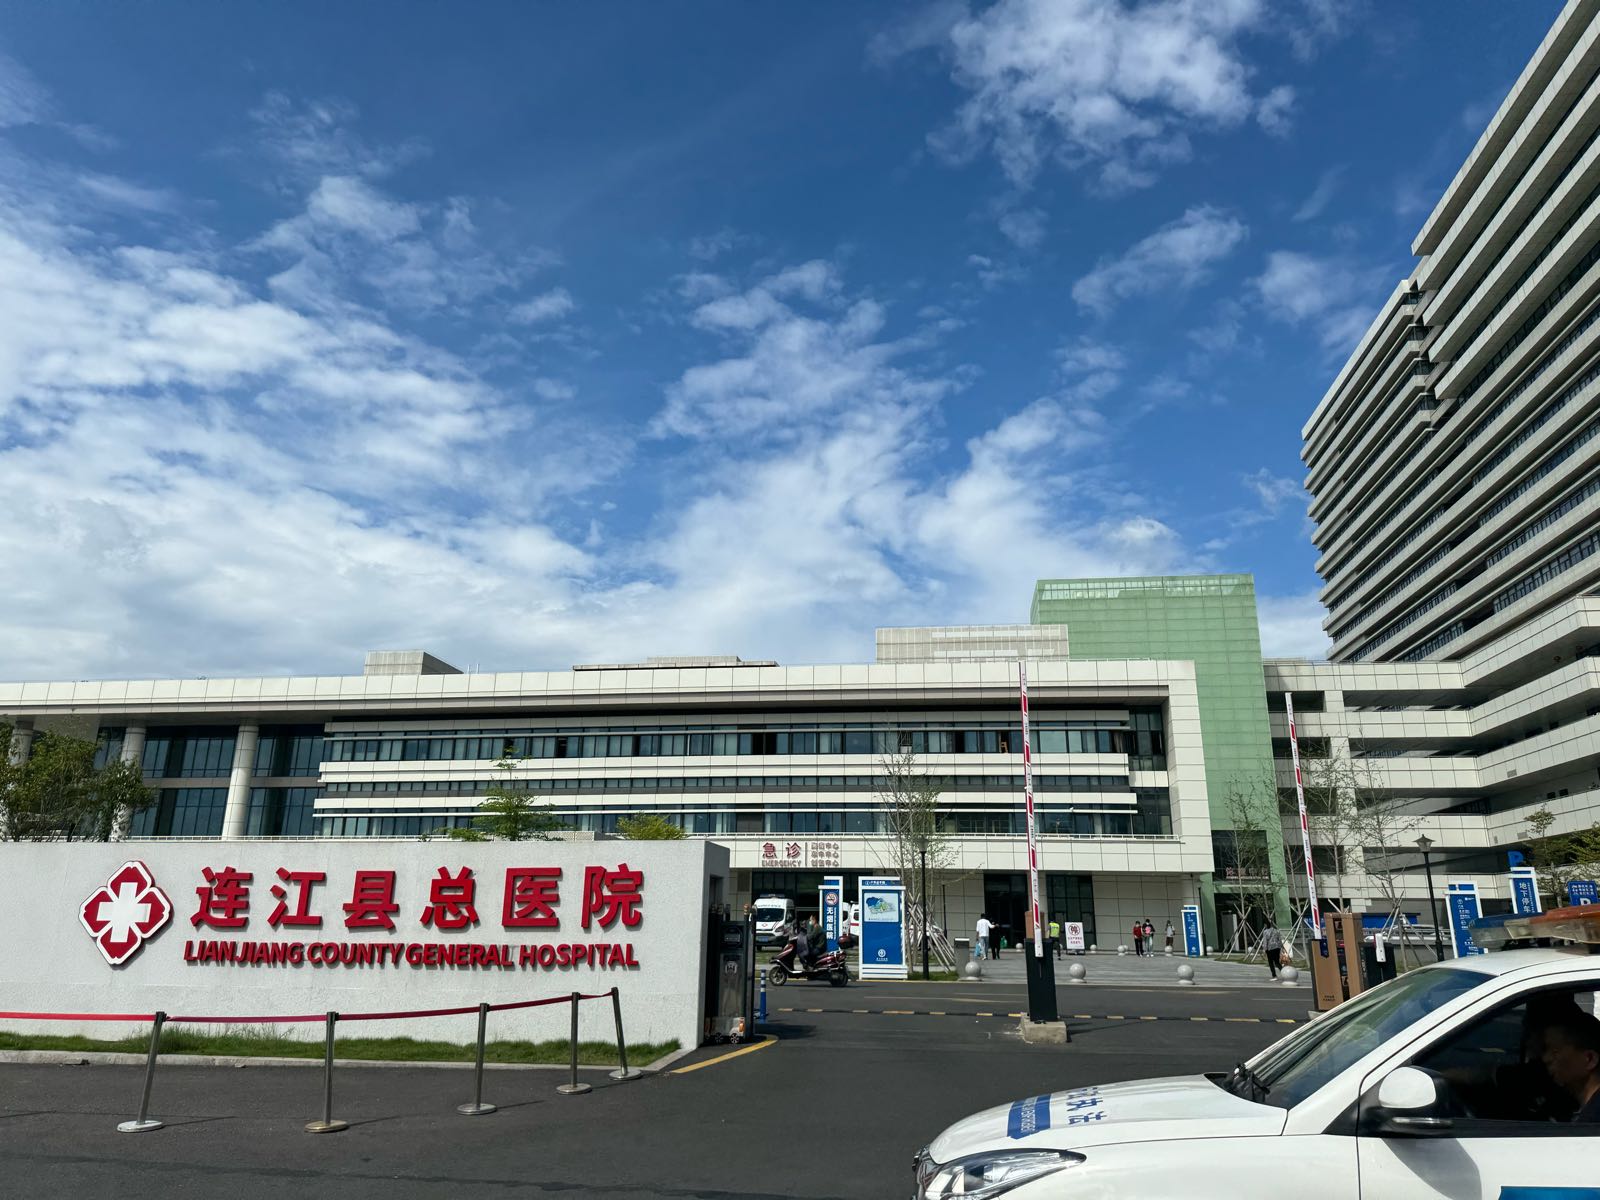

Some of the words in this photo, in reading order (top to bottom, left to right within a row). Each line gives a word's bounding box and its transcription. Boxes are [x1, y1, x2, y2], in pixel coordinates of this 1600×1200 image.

[762, 842, 801, 859] 急诊
[191, 864, 643, 930] 连江县总医院
[184, 940, 303, 965] LIANJIANG
[307, 942, 404, 966] COUNTY
[406, 943, 513, 967] GENERAL
[517, 944, 638, 968] HOSPITAL
